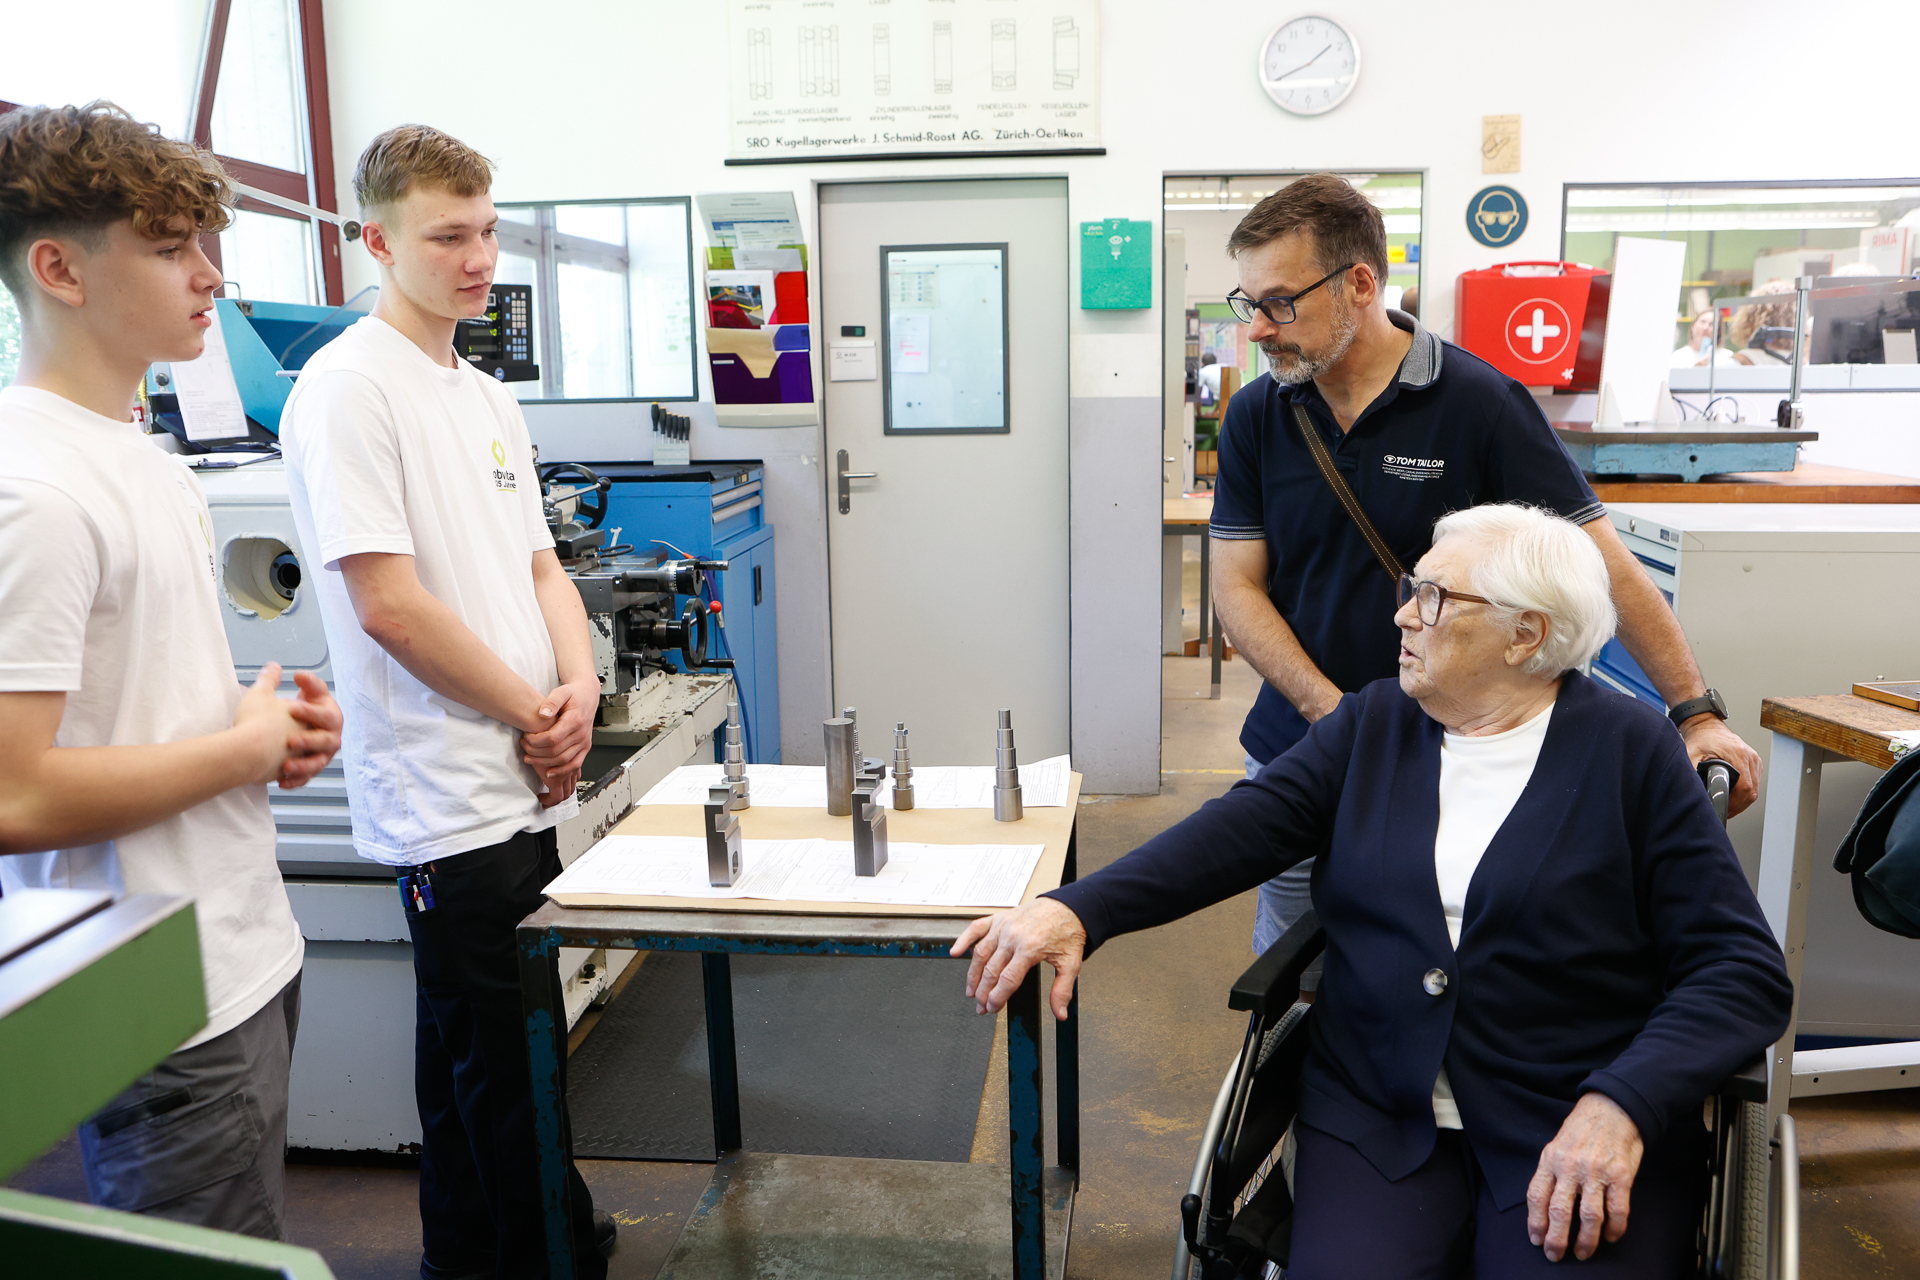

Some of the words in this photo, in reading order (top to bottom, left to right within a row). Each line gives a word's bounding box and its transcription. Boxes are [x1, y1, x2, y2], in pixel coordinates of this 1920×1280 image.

[746, 137, 770, 148] SRO
[776, 134, 866, 149] Kugellagerwerke
[872, 133, 880, 143] J.
[883, 131, 956, 143] Schmid-Roost
[962, 129, 984, 141] AG.
[995, 128, 1083, 140] Zürich-Oerlikon
[1396, 456, 1416, 466] TOM
[1417, 459, 1444, 467] TAILOR
